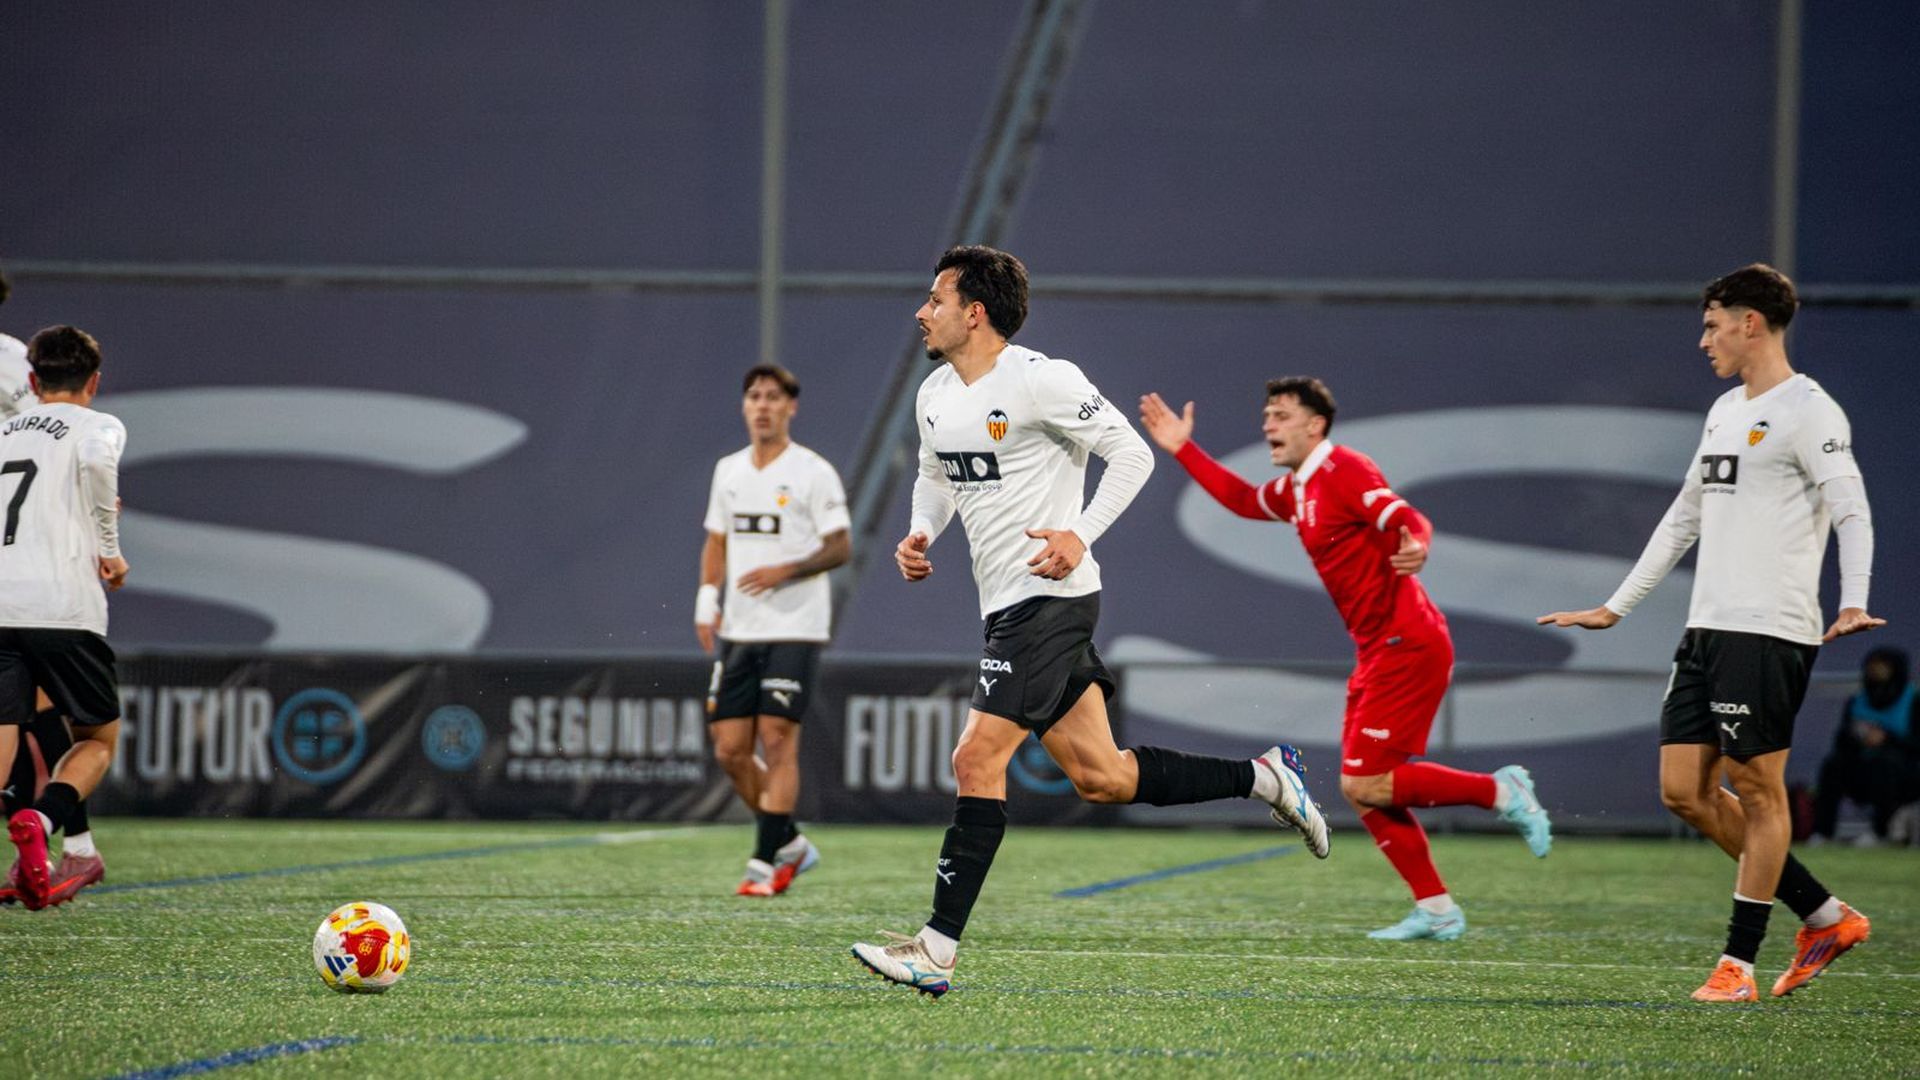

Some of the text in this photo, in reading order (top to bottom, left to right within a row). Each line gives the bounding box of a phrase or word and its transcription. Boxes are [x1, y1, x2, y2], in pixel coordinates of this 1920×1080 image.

[3, 416, 70, 441] JURADO
[0, 458, 38, 547] 7
[508, 696, 704, 755] SEGUNDA
